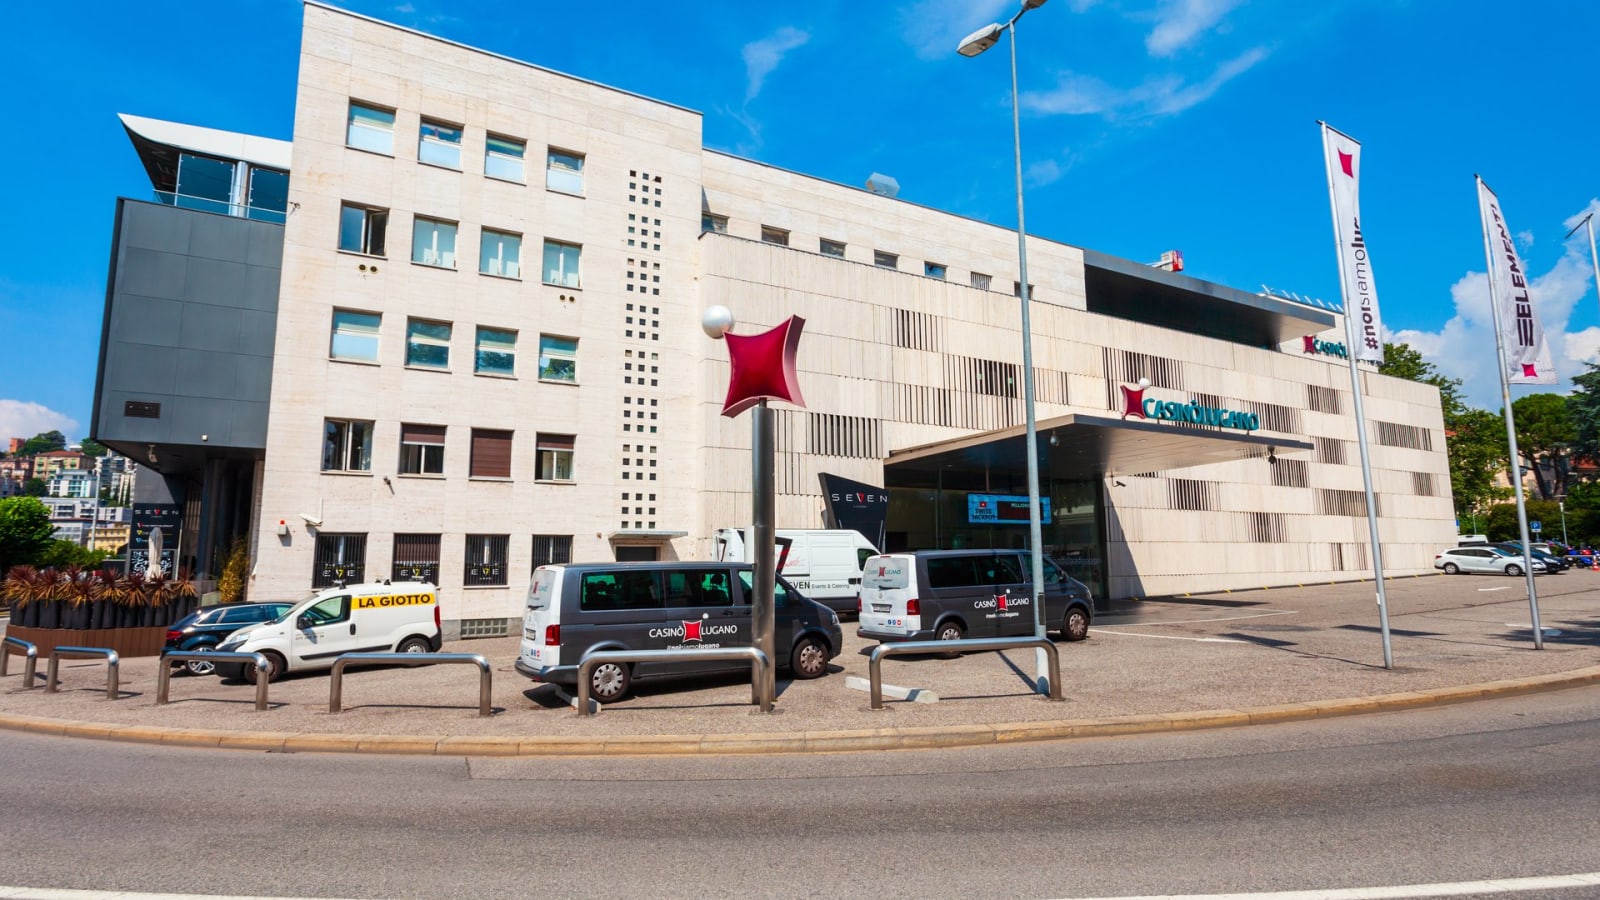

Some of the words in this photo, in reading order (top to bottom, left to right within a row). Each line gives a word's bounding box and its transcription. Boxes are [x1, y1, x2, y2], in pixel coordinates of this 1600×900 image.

[831, 492, 888, 503] SEVEN
[134, 508, 179, 516] SEVEN
[832, 582, 850, 590] Catering
[358, 598, 376, 608] LA
[380, 594, 431, 606] GIOTTO
[1006, 597, 1030, 606] LUGANO
[648, 625, 685, 638] CASINÒ
[701, 624, 738, 635] LUGANO
